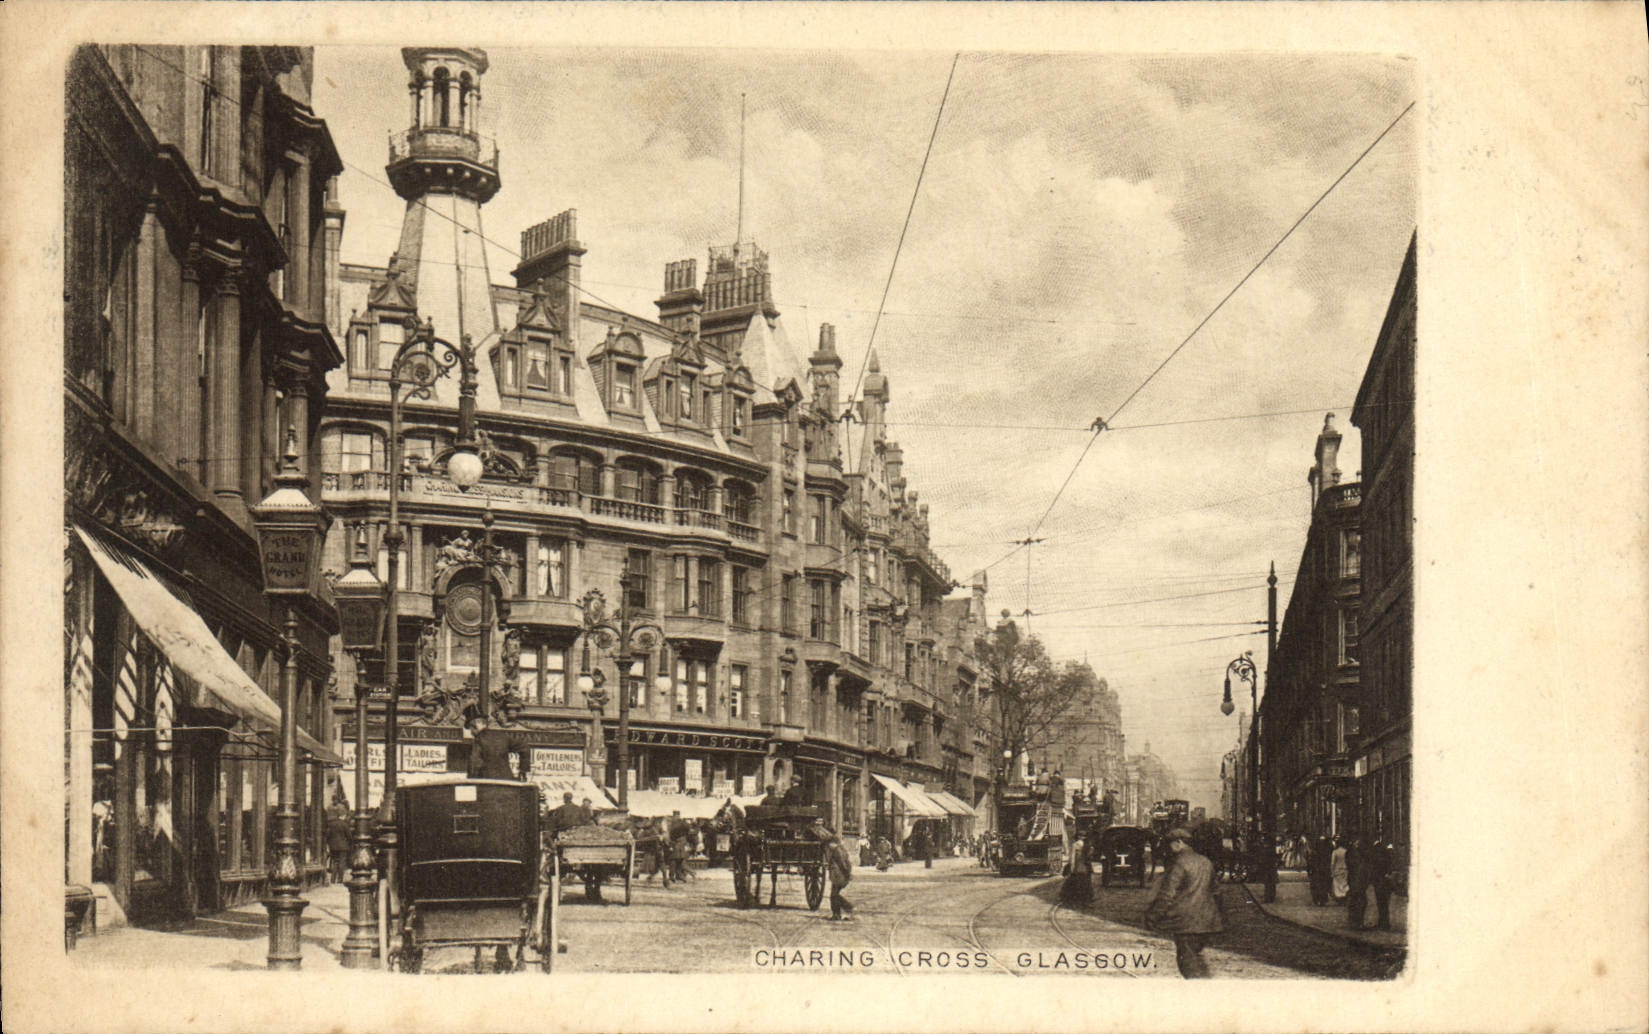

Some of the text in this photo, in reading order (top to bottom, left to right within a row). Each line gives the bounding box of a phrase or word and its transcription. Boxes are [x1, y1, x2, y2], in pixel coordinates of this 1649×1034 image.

[271, 536, 300, 548] THE
[265, 551, 305, 563] GRAND
[269, 566, 303, 579] HOTEL
[408, 748, 441, 759] LADIES
[405, 759, 444, 769] TAILORS
[541, 762, 577, 772] TAILORS
